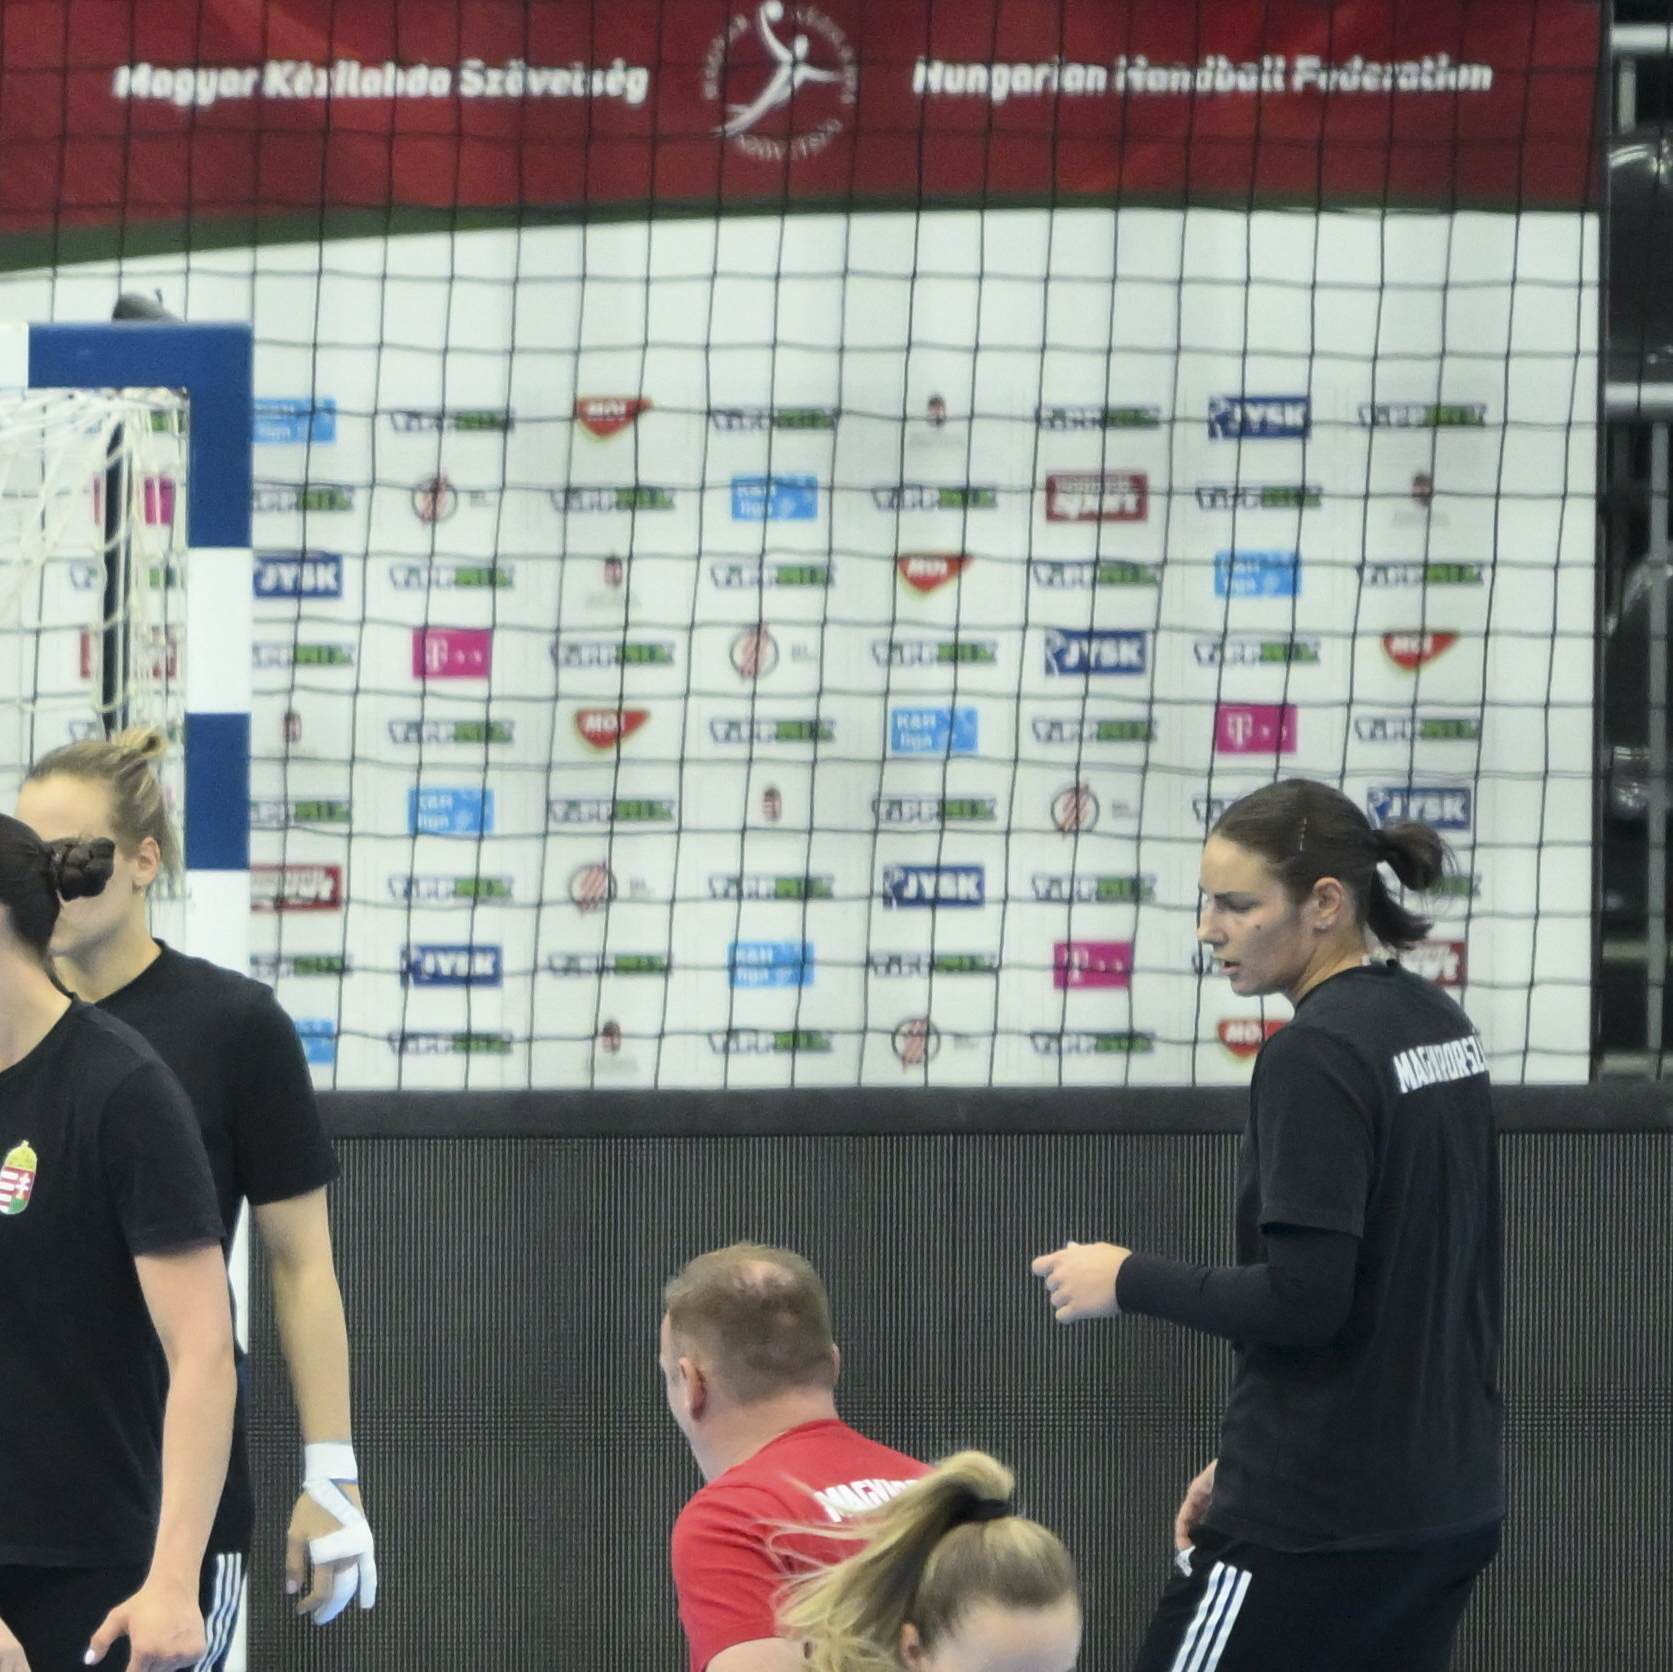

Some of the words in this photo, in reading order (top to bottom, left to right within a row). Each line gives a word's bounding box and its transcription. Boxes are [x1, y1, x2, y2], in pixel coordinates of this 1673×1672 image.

[112, 60, 256, 109] Magyar
[458, 57, 650, 106] Szövetség
[912, 54, 1107, 105] Hungarian
[1115, 53, 1284, 94] Handball
[1292, 51, 1494, 94] Federation
[1063, 639, 1142, 667] JYSK
